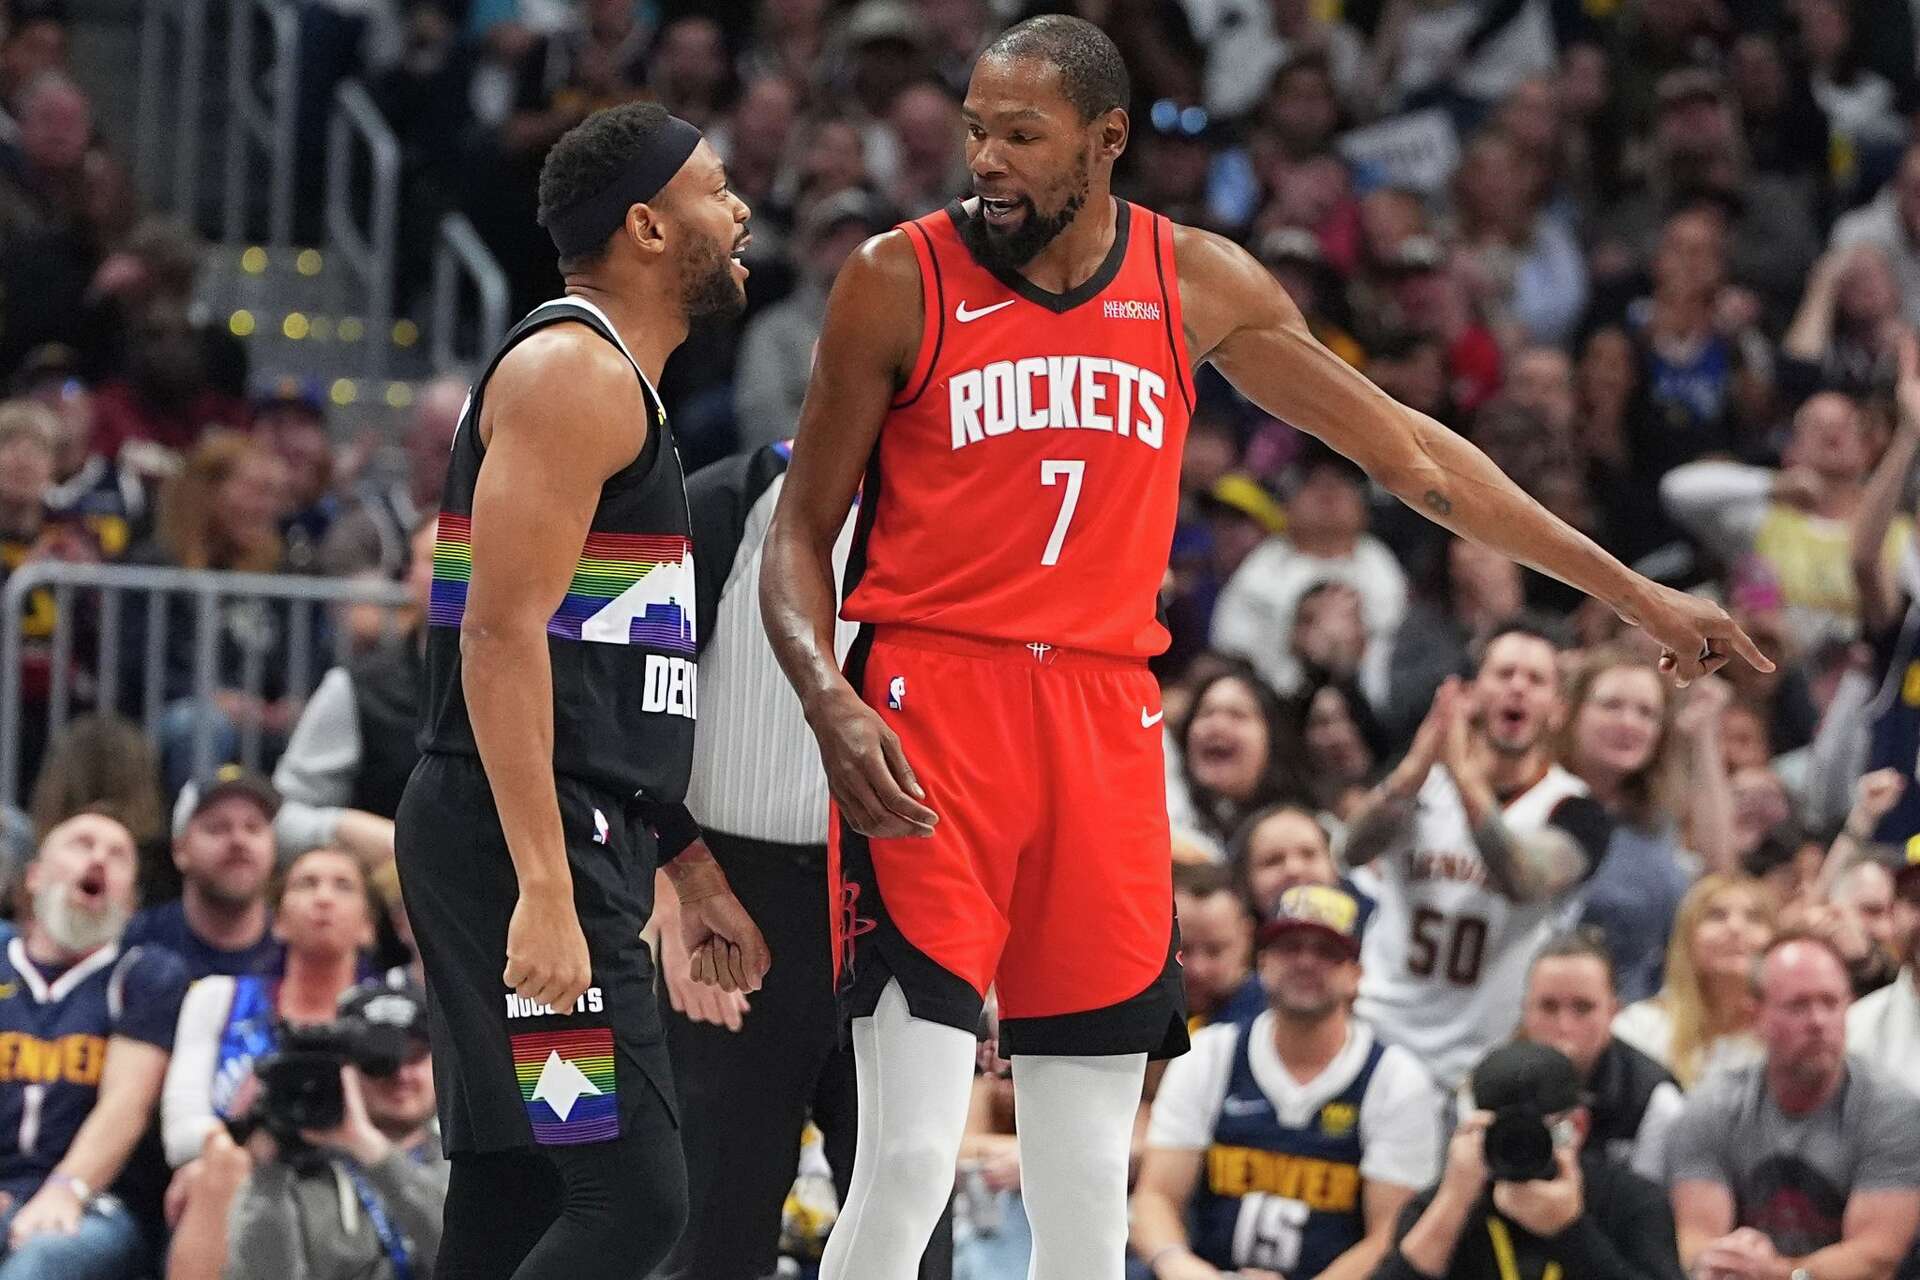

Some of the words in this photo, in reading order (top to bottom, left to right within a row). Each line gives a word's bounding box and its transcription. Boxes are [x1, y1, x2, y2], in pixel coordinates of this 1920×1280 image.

[1104, 300, 1158, 312] MEMORIAL
[1104, 309, 1160, 320] HERMANN
[949, 355, 1166, 451] ROCKETS
[1040, 459, 1086, 566] 7
[1407, 903, 1487, 986] 50
[18, 1084, 45, 1158] 1
[1208, 1143, 1359, 1212] DENVER
[1231, 1191, 1311, 1271] 15
